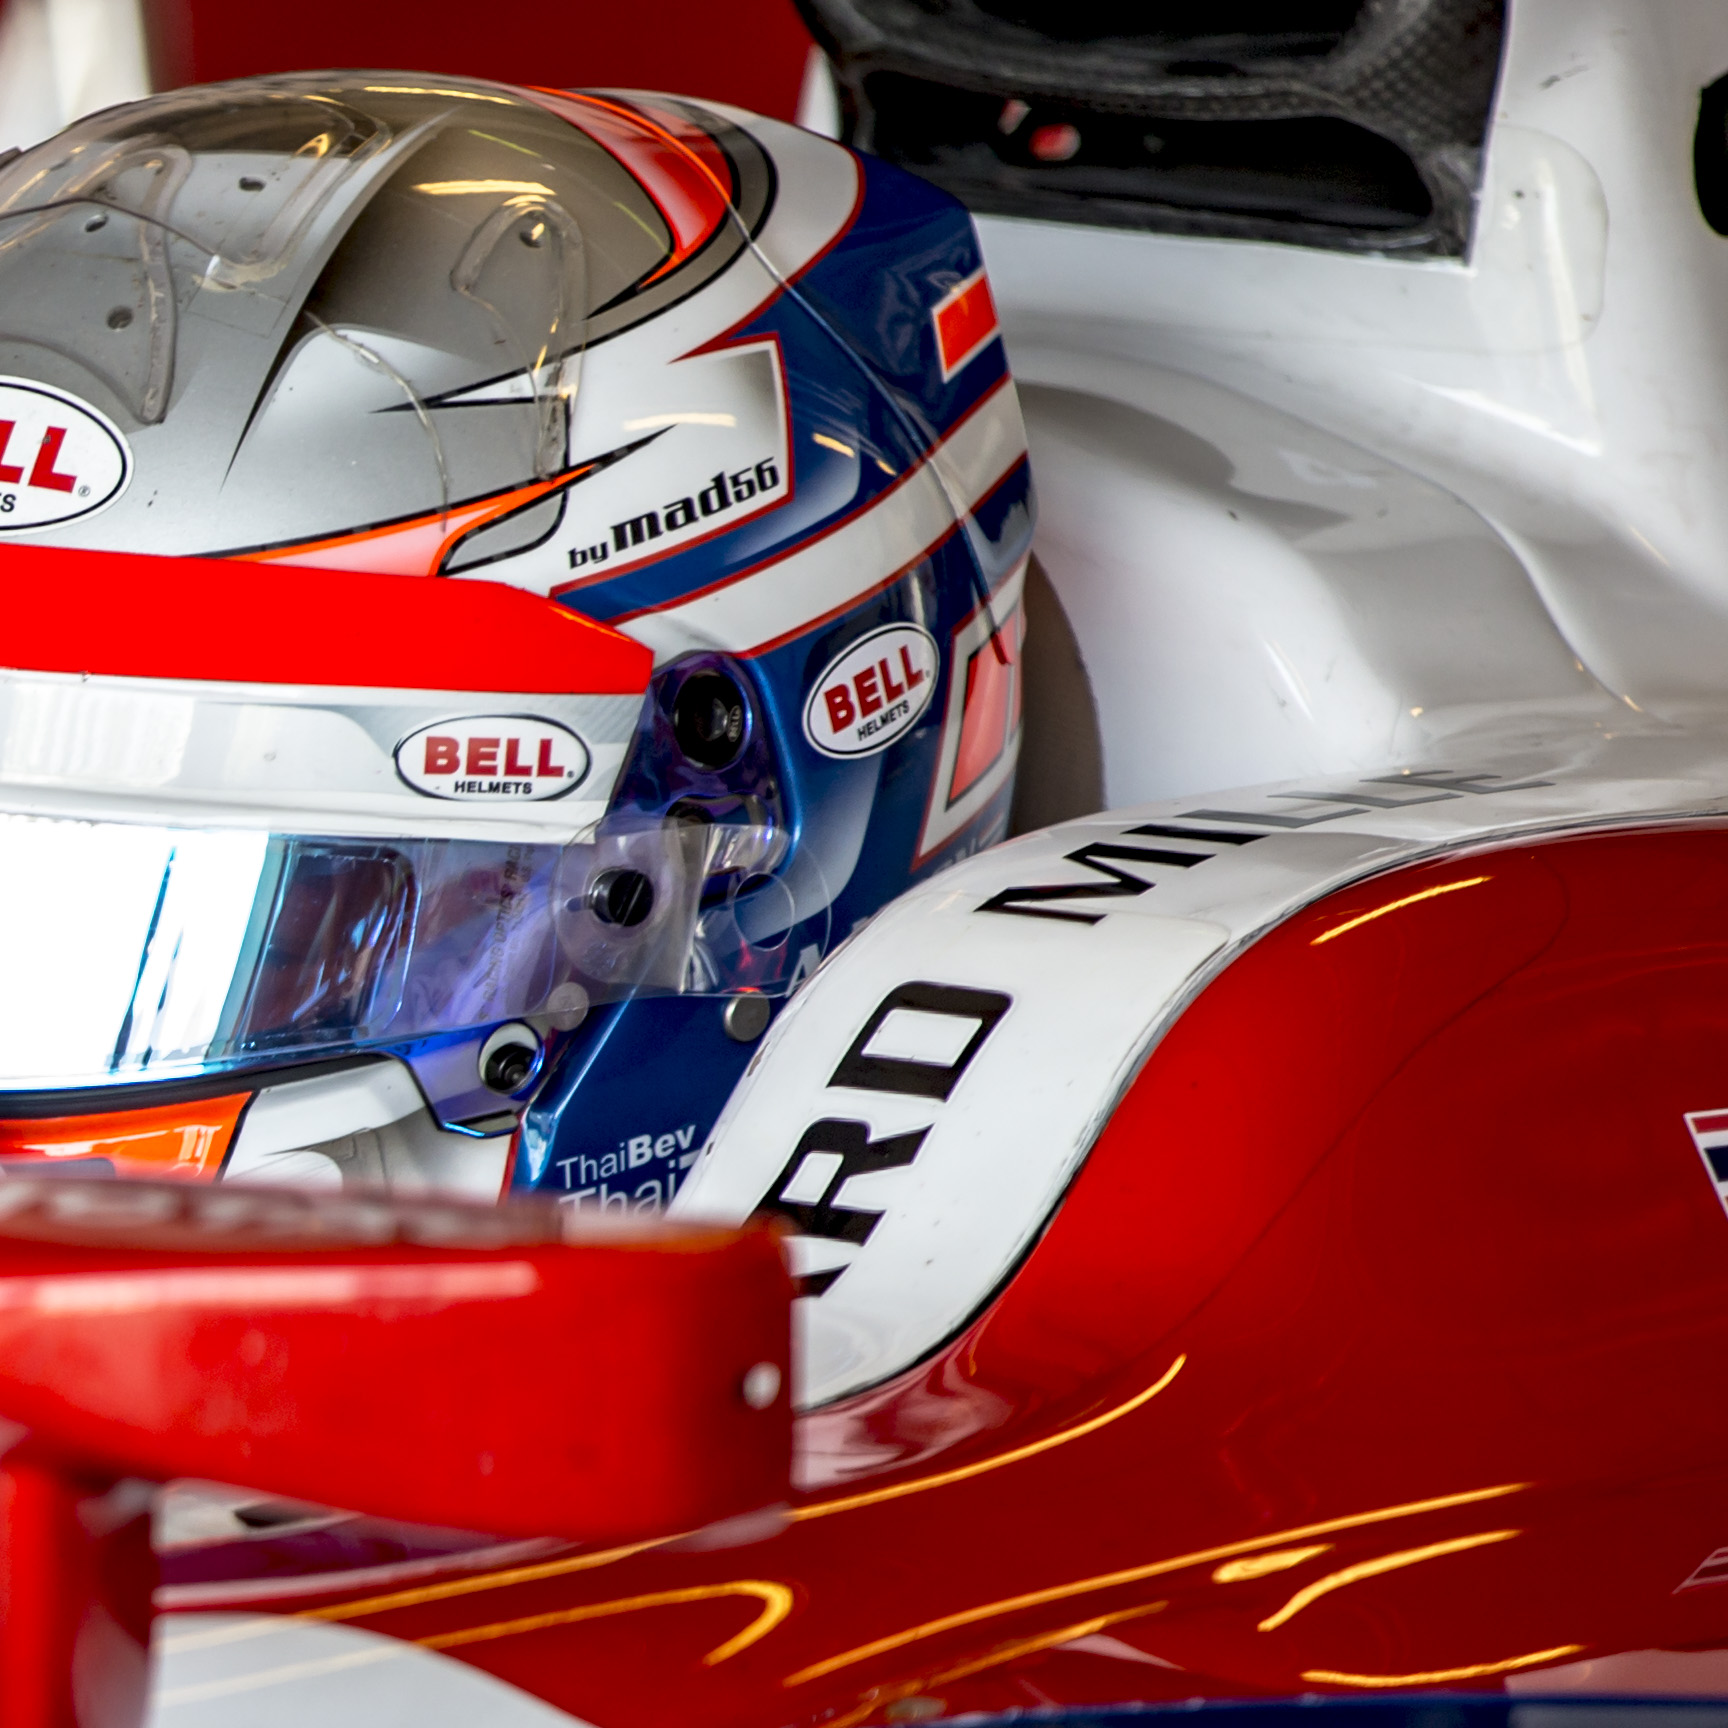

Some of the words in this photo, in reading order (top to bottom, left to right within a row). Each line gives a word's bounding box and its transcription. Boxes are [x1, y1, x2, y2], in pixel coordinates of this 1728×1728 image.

[568, 542, 610, 571] by
[612, 456, 780, 552] mad56
[824, 644, 925, 733] BELL
[856, 701, 911, 742] HELMETS
[423, 737, 566, 778] BELL
[453, 780, 533, 796] HELMETS
[740, 978, 1014, 1299] RD
[972, 769, 1556, 925] MILLE
[556, 1124, 696, 1190] ThaiBev
